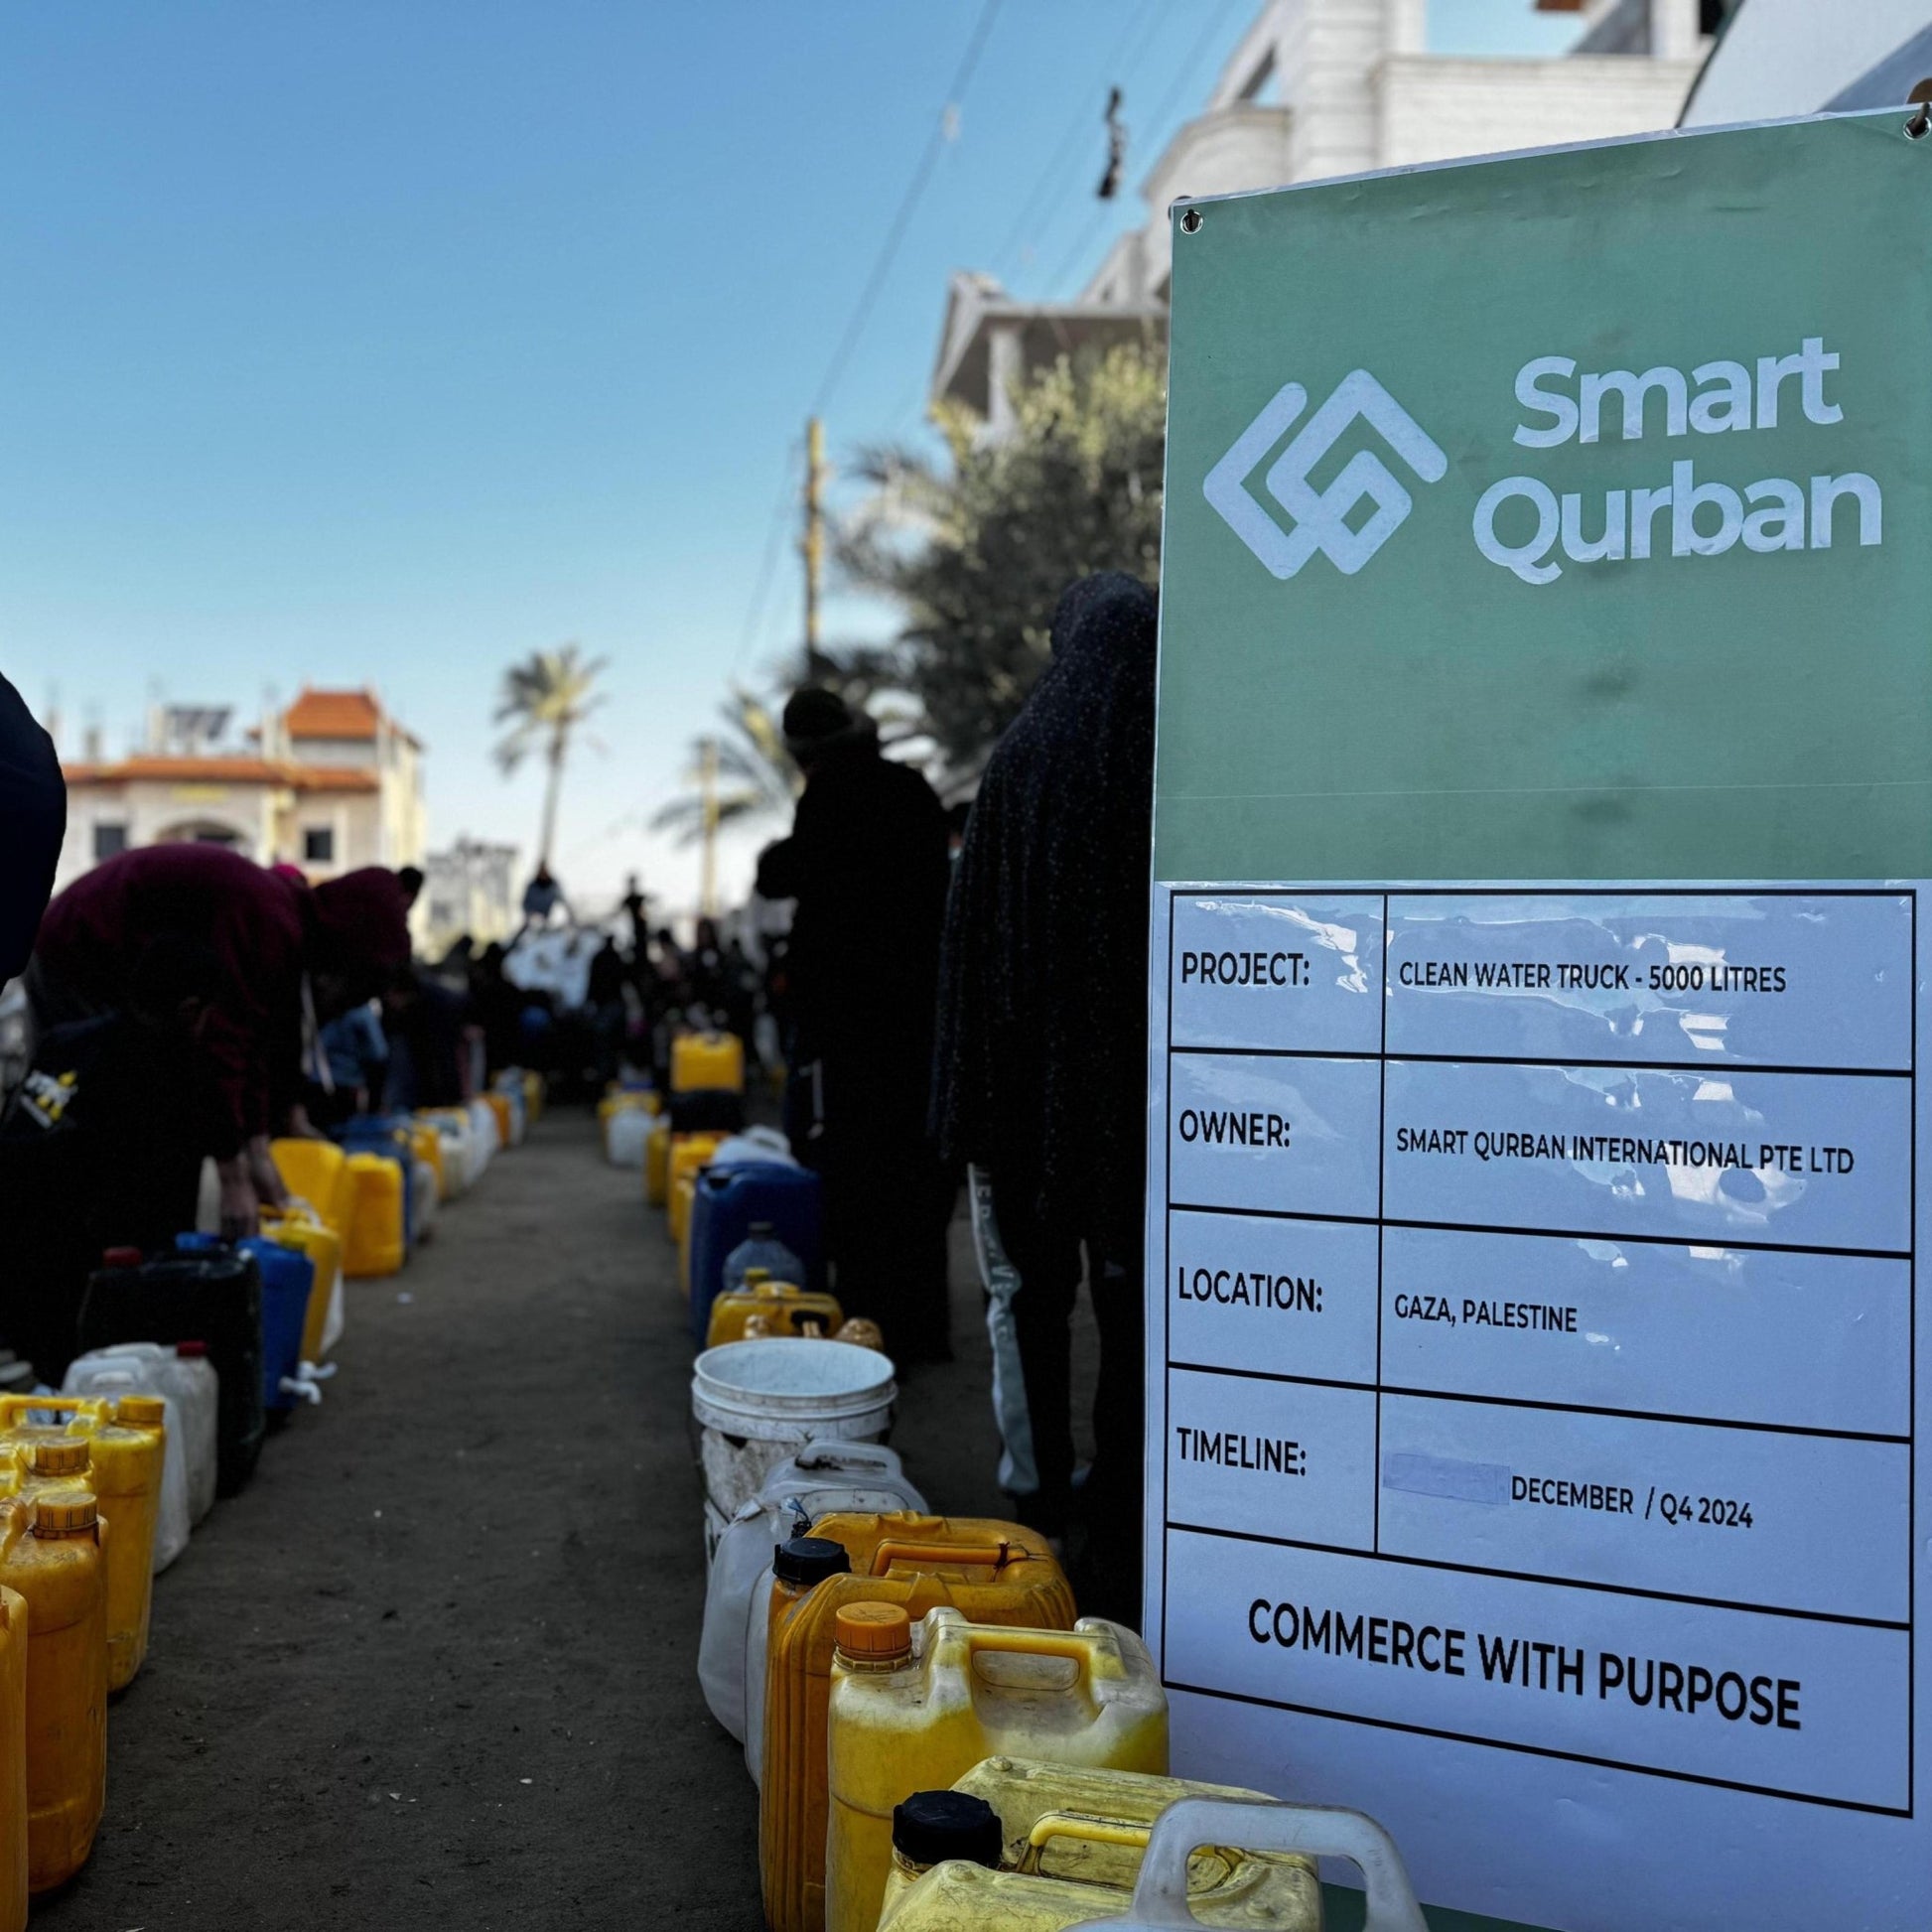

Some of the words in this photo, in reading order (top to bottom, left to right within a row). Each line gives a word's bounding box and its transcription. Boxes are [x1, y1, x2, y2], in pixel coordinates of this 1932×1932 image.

[1512, 337, 1844, 449] Smart
[1472, 460, 1882, 585] Qurban
[1181, 951, 1310, 986] PROJECT:
[1399, 961, 1468, 987] CLEAN
[1473, 962, 1551, 989] WATER
[1556, 963, 1629, 990] TRUCK
[1648, 964, 1704, 991] 5000
[1711, 966, 1786, 993] LITRES
[1178, 1109, 1291, 1148] OWNER:
[1396, 1127, 1469, 1155] SMART
[1473, 1131, 1566, 1162] QURBAN
[1573, 1135, 1753, 1170] INTERNATIONAL
[1759, 1144, 1803, 1172] PTE
[1810, 1146, 1855, 1174] LTD
[1178, 1266, 1322, 1313] LOCATION:
[1394, 1294, 1456, 1327] GAZA,
[1462, 1299, 1578, 1333] PALESTINE
[1175, 1427, 1307, 1476] TIMELINE:
[1511, 1475, 1634, 1515] DECEMBER
[1644, 1485, 1656, 1521] /
[1660, 1492, 1694, 1526] Q4
[1698, 1496, 1753, 1529] 2024
[1248, 1597, 1466, 1677] COMMERCE
[1476, 1633, 1585, 1697] WITH
[1598, 1651, 1802, 1731] PURPOSE
